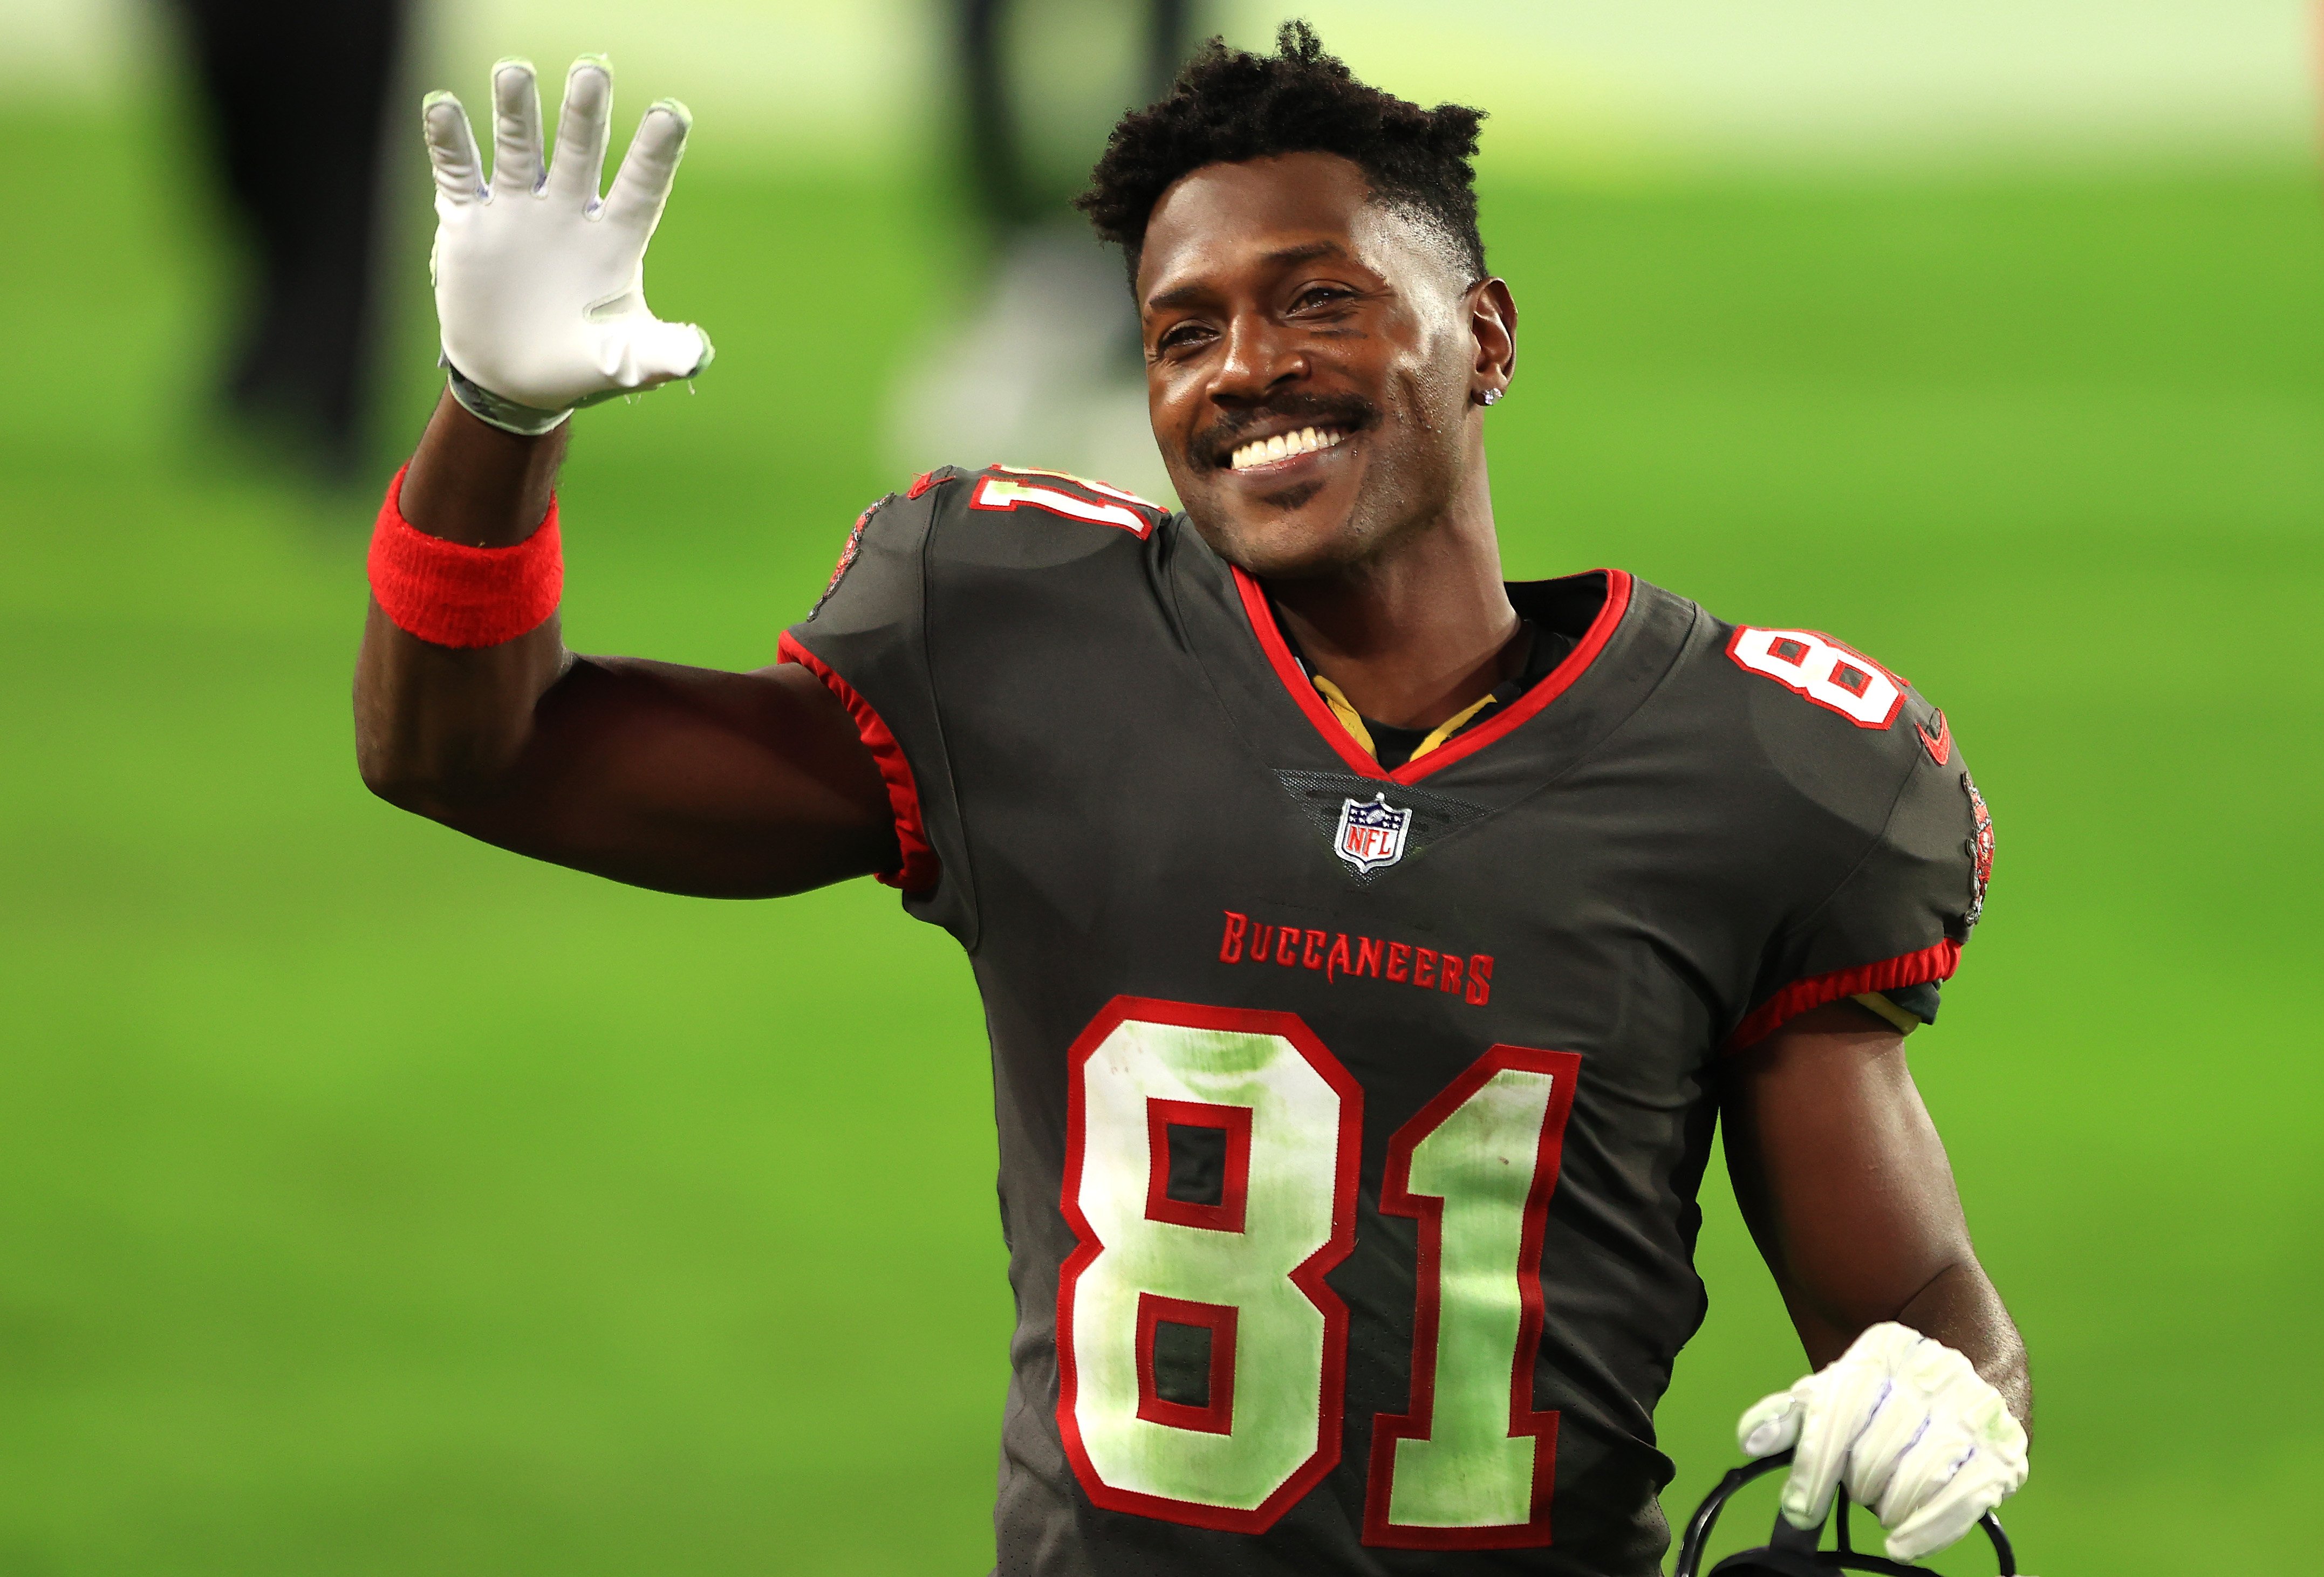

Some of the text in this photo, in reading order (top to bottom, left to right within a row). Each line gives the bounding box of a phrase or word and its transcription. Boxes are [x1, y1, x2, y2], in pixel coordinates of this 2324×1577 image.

[1346, 826, 1392, 857] NFL
[1219, 910, 1494, 1006] BUCCANEERS
[1056, 995, 1582, 1549] 81
